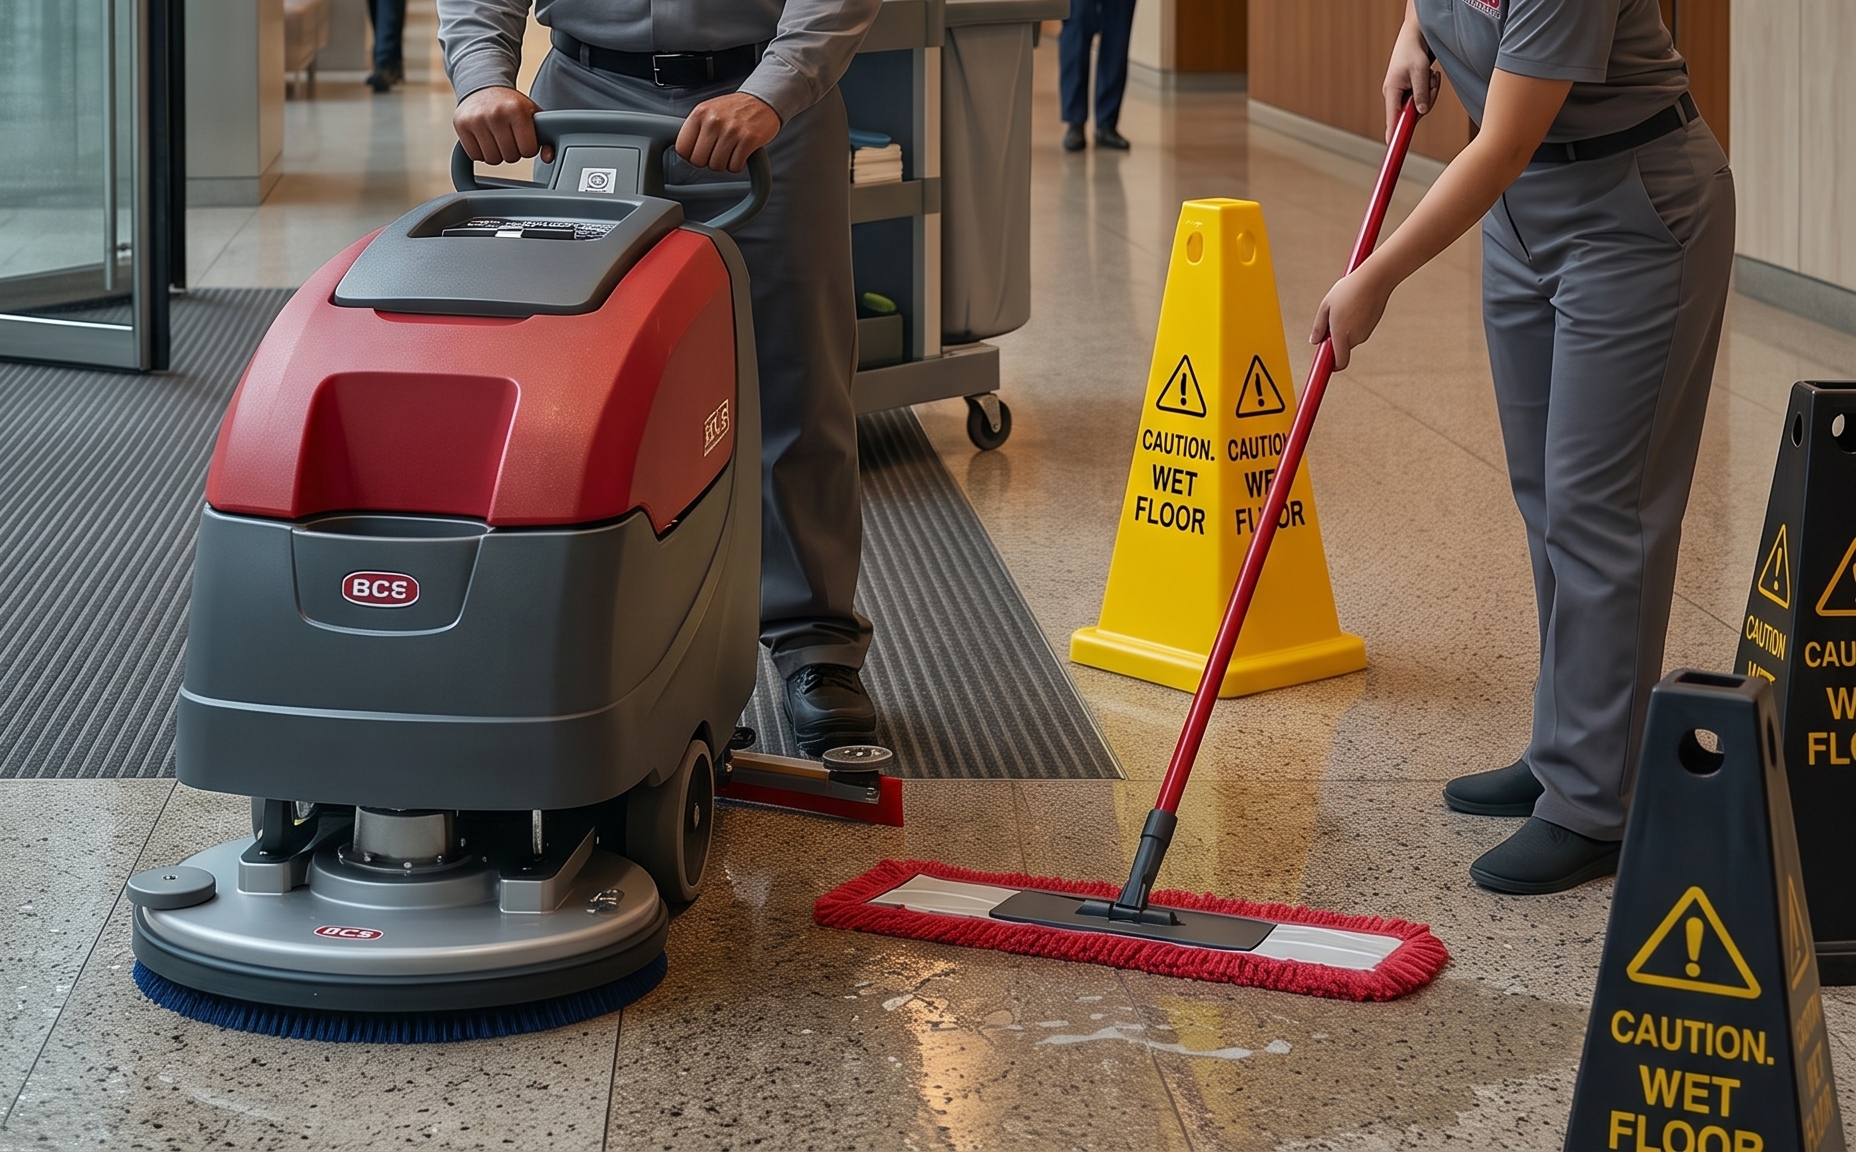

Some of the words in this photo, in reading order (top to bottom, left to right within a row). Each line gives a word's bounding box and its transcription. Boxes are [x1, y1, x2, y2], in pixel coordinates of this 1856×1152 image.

[1142, 429, 1215, 461] CAUTION.
[1227, 432, 1287, 462] CAUTIO
[1152, 464, 1198, 497] WET
[1134, 495, 1206, 535] FLOOR
[1746, 615, 1787, 661] CAUTION
[1808, 732, 1856, 766] FL
[1611, 1009, 1775, 1066] CAUTION.
[1639, 1064, 1741, 1118] WET
[1608, 1110, 1764, 1152] FLOOR
